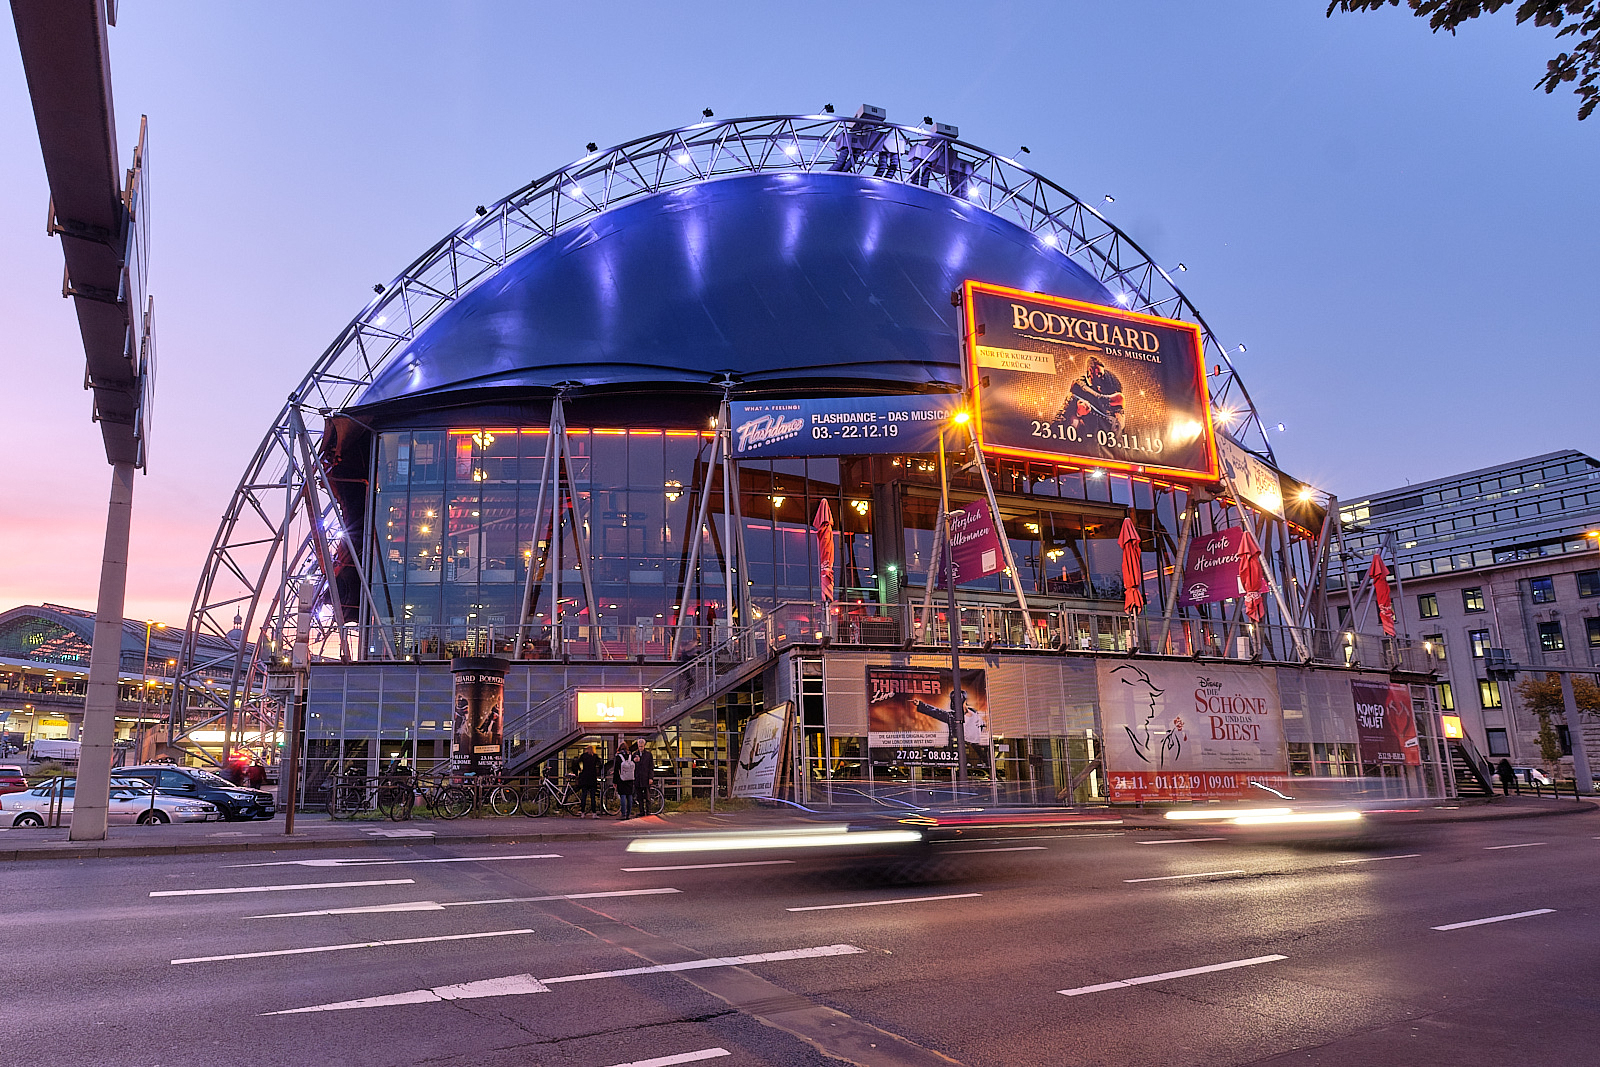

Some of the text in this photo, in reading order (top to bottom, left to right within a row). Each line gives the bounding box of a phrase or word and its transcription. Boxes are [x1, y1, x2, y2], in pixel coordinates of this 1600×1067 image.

[1011, 303, 1160, 353] BODYGUARD
[980, 349, 995, 357] NUR
[996, 351, 1010, 359] FÜR
[1011, 353, 1033, 361] KURZE
[1105, 347, 1161, 364] DAS MUSICAL
[1001, 360, 1031, 369] ZURÜCK!
[811, 412, 877, 424] FLASHDANCE
[888, 411, 909, 422] DAS
[736, 414, 805, 453] Flashdance
[1031, 420, 1083, 443] 23.10.
[1097, 429, 1163, 454] 03.11.19
[950, 508, 982, 532] Herzlich
[1206, 535, 1230, 555] Gute
[1194, 553, 1240, 572] Heimreis
[870, 678, 942, 695] THRILLER
[1206, 688, 1219, 696] DIE
[870, 690, 896, 703] Live
[1194, 688, 1268, 715] SCHÖNE
[596, 702, 624, 717] Dom
[1356, 702, 1385, 717] ROMEO
[1224, 715, 1239, 723] UND
[1208, 715, 1261, 741] BIEST
[896, 750, 922, 760] 27.02.
[928, 751, 959, 760] 08.03.2
[1155, 776, 1200, 789] 01.12.19
